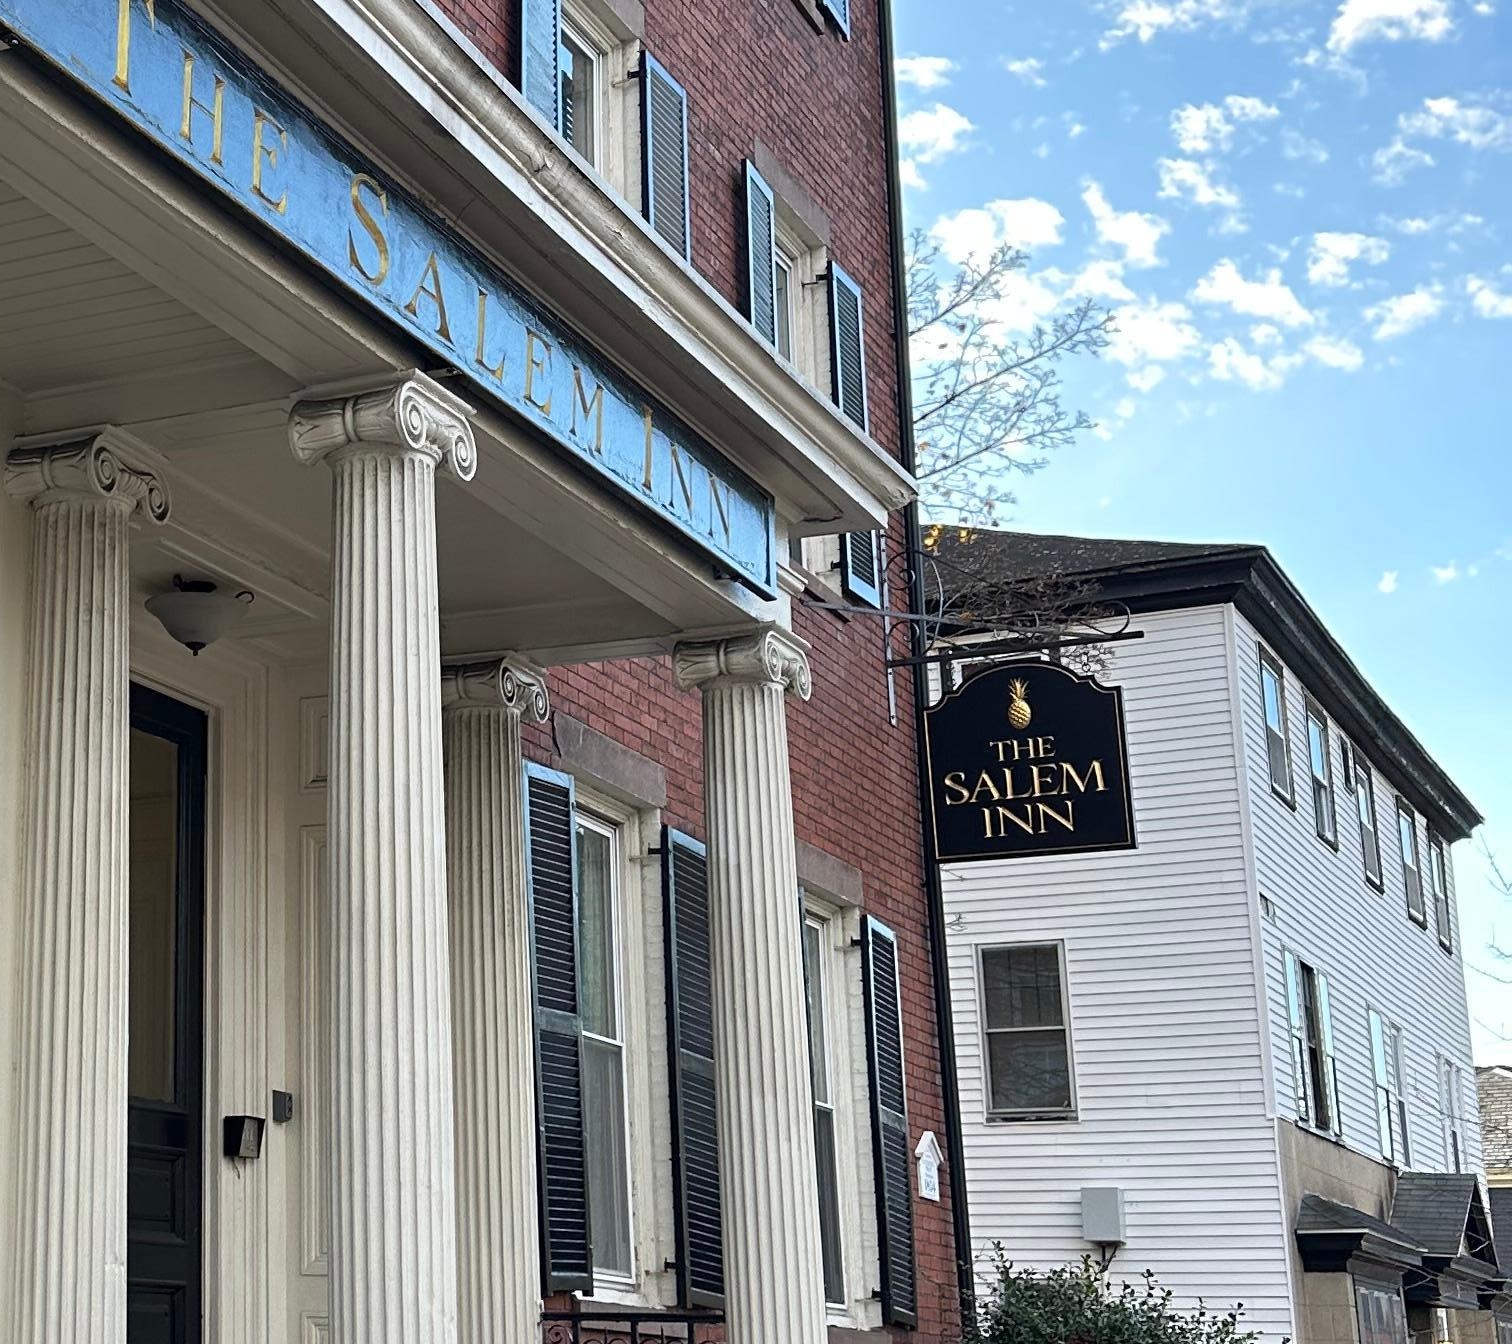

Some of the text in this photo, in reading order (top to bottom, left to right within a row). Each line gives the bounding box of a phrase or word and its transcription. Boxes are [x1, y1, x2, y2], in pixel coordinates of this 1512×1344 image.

[348, 172, 605, 456] SALEM
[642, 406, 731, 546] INN
[989, 735, 1057, 762] THE
[944, 759, 1109, 806] SALEM
[981, 800, 1076, 839] INN
